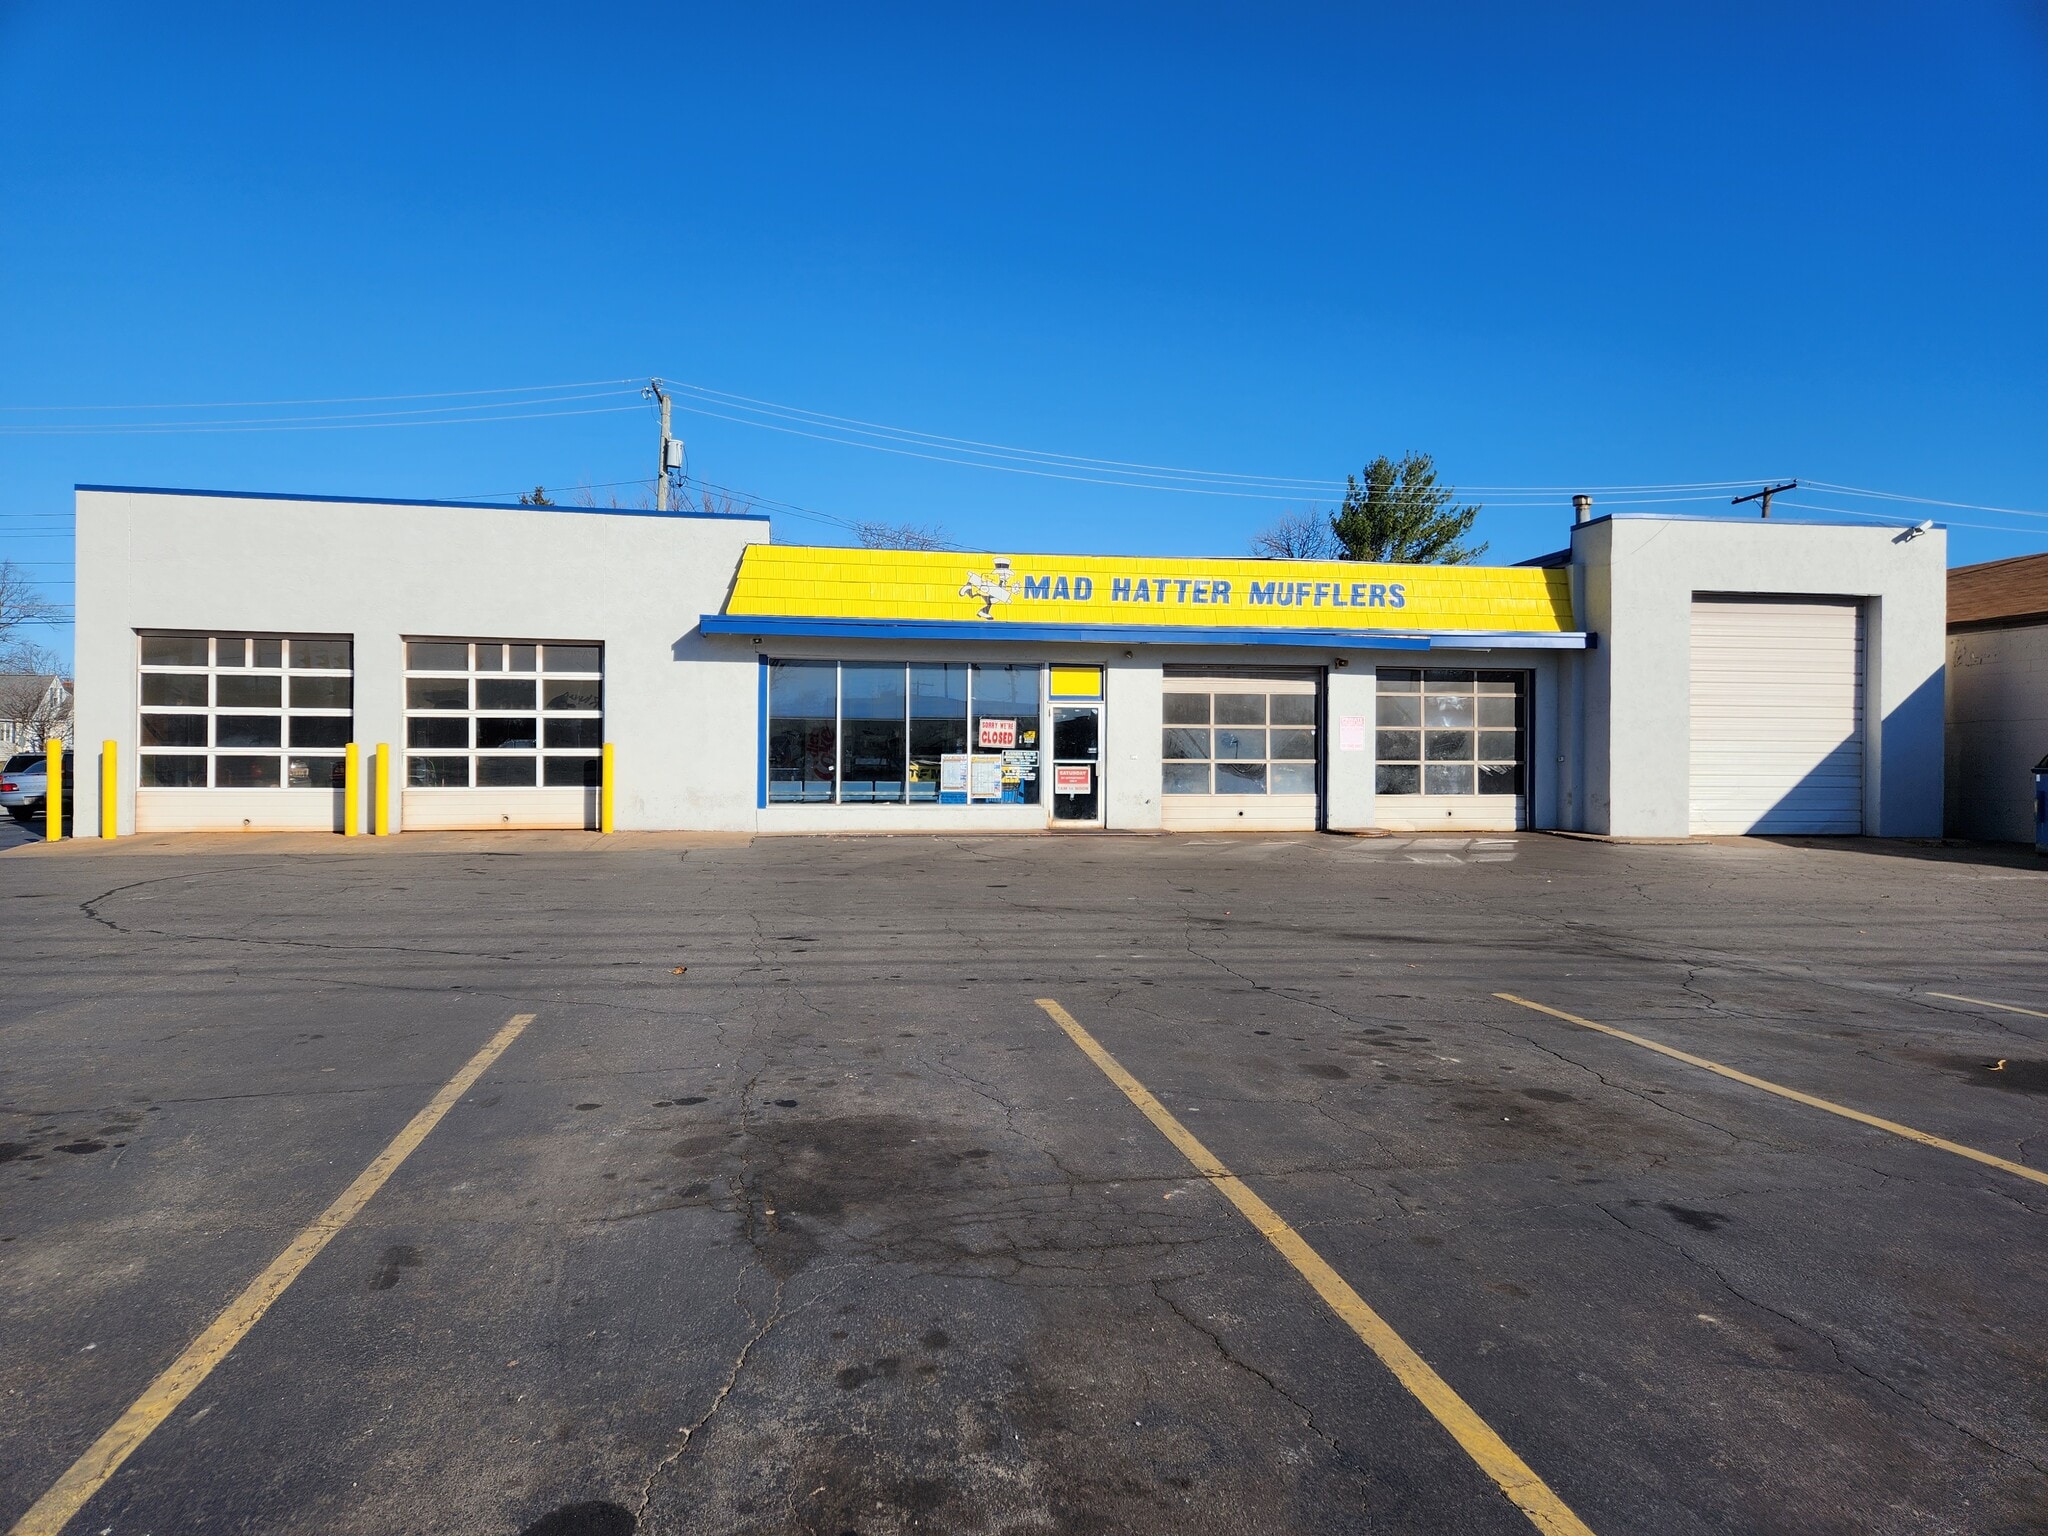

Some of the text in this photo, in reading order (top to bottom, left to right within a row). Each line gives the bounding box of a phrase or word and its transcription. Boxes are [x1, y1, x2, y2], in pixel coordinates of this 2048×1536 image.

[1024, 575, 1407, 609] MAD HATTER MUFFLERS
[982, 721, 1014, 730] SORRY WE'RE
[981, 731, 1014, 745] CLOSED
